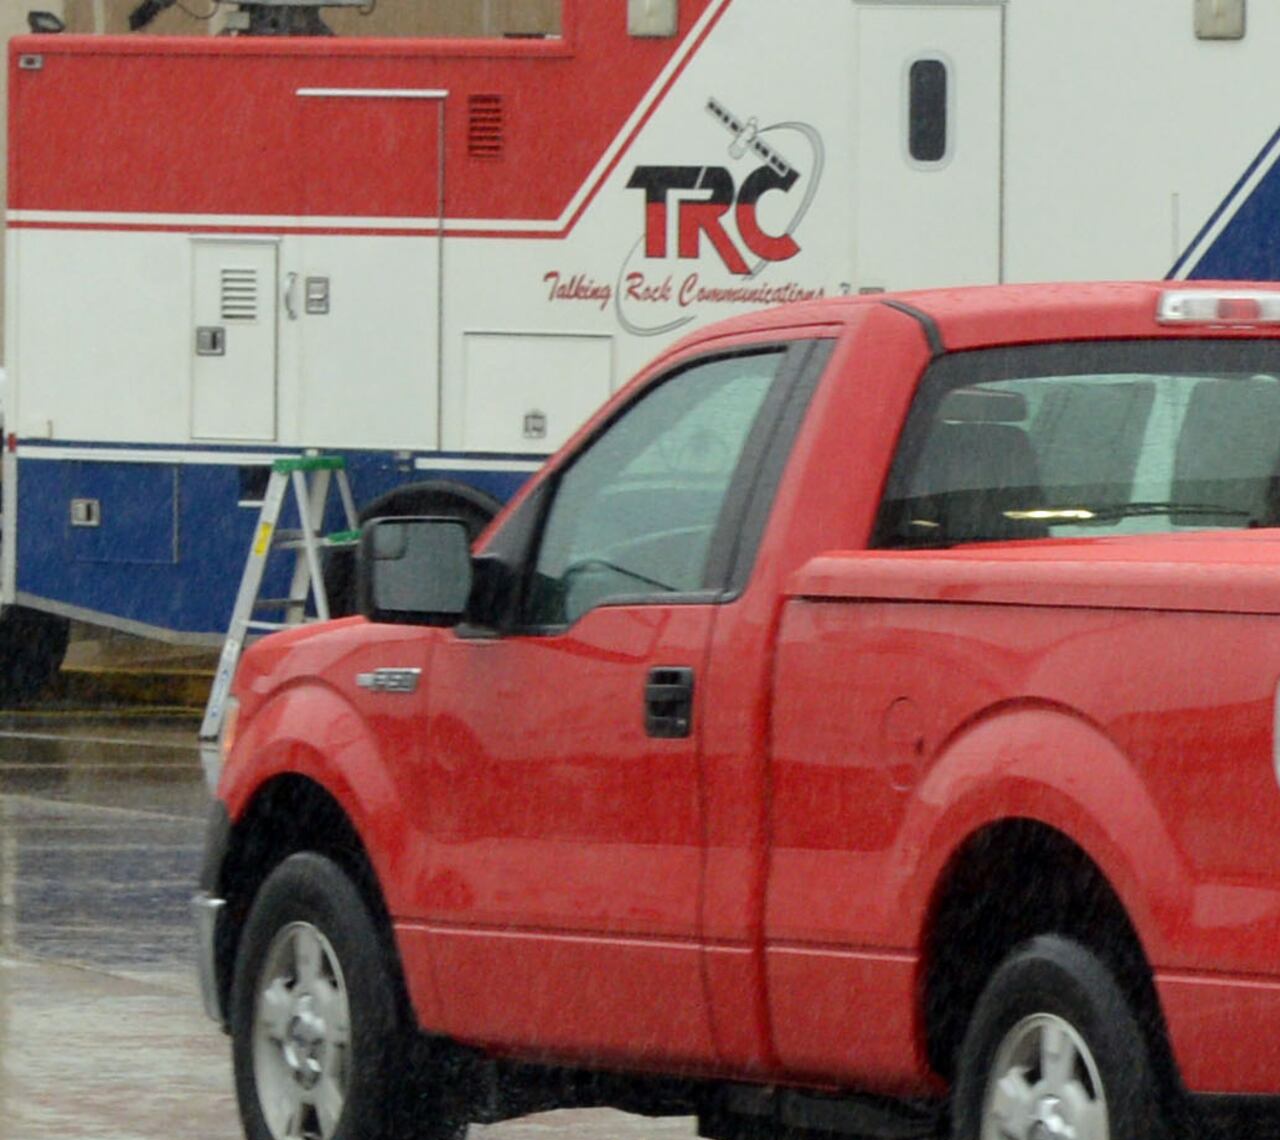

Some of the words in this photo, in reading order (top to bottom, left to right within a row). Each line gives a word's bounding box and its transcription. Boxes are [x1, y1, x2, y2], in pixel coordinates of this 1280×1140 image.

[625, 165, 802, 276] TRC
[543, 271, 612, 311] Talking
[625, 271, 672, 302] Rock
[678, 272, 825, 307] Communications
